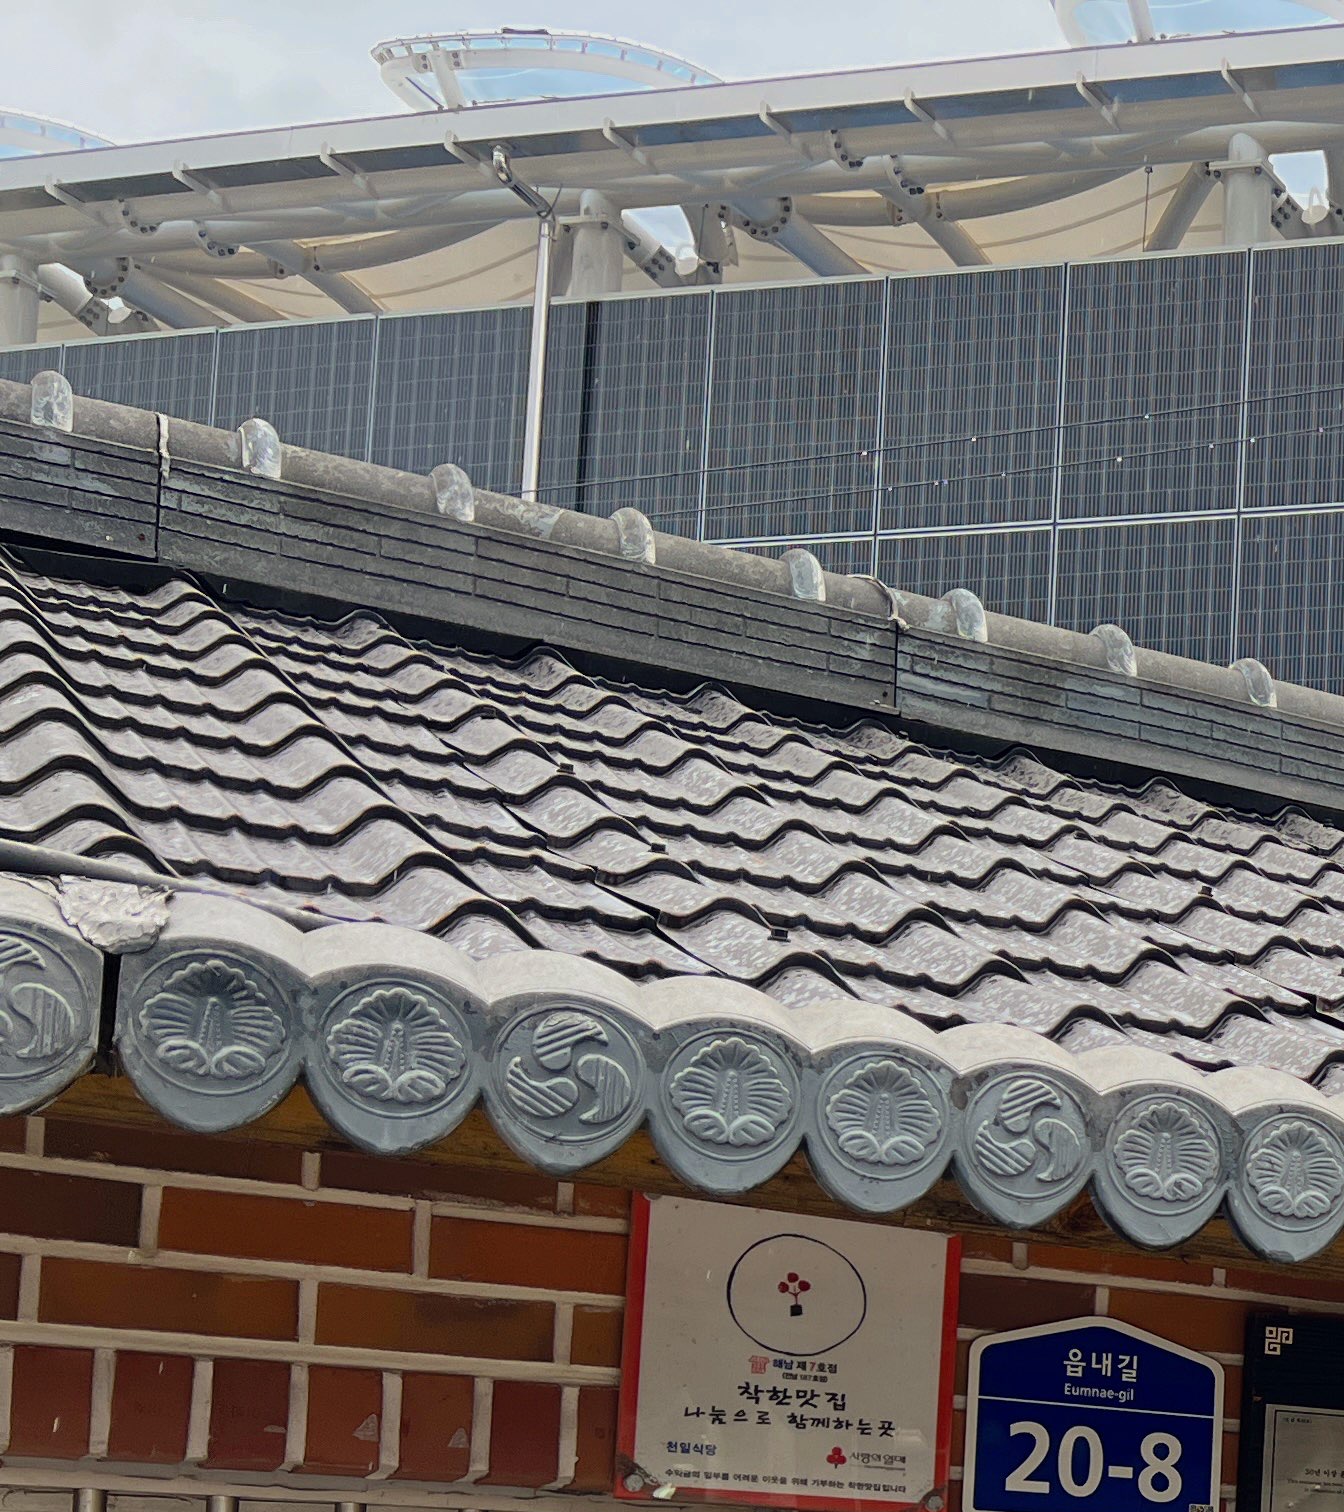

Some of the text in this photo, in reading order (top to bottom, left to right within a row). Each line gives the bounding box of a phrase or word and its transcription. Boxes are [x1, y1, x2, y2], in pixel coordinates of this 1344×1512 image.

[1063, 1348, 1139, 1383] 읍내길
[737, 1381, 847, 1411] 착한맛집
[1063, 1382, 1134, 1402] Eumnae-gil
[684, 1406, 773, 1426] 나눔으로
[666, 1440, 718, 1456] 천일식당
[1004, 1420, 1183, 1503] 20-8
